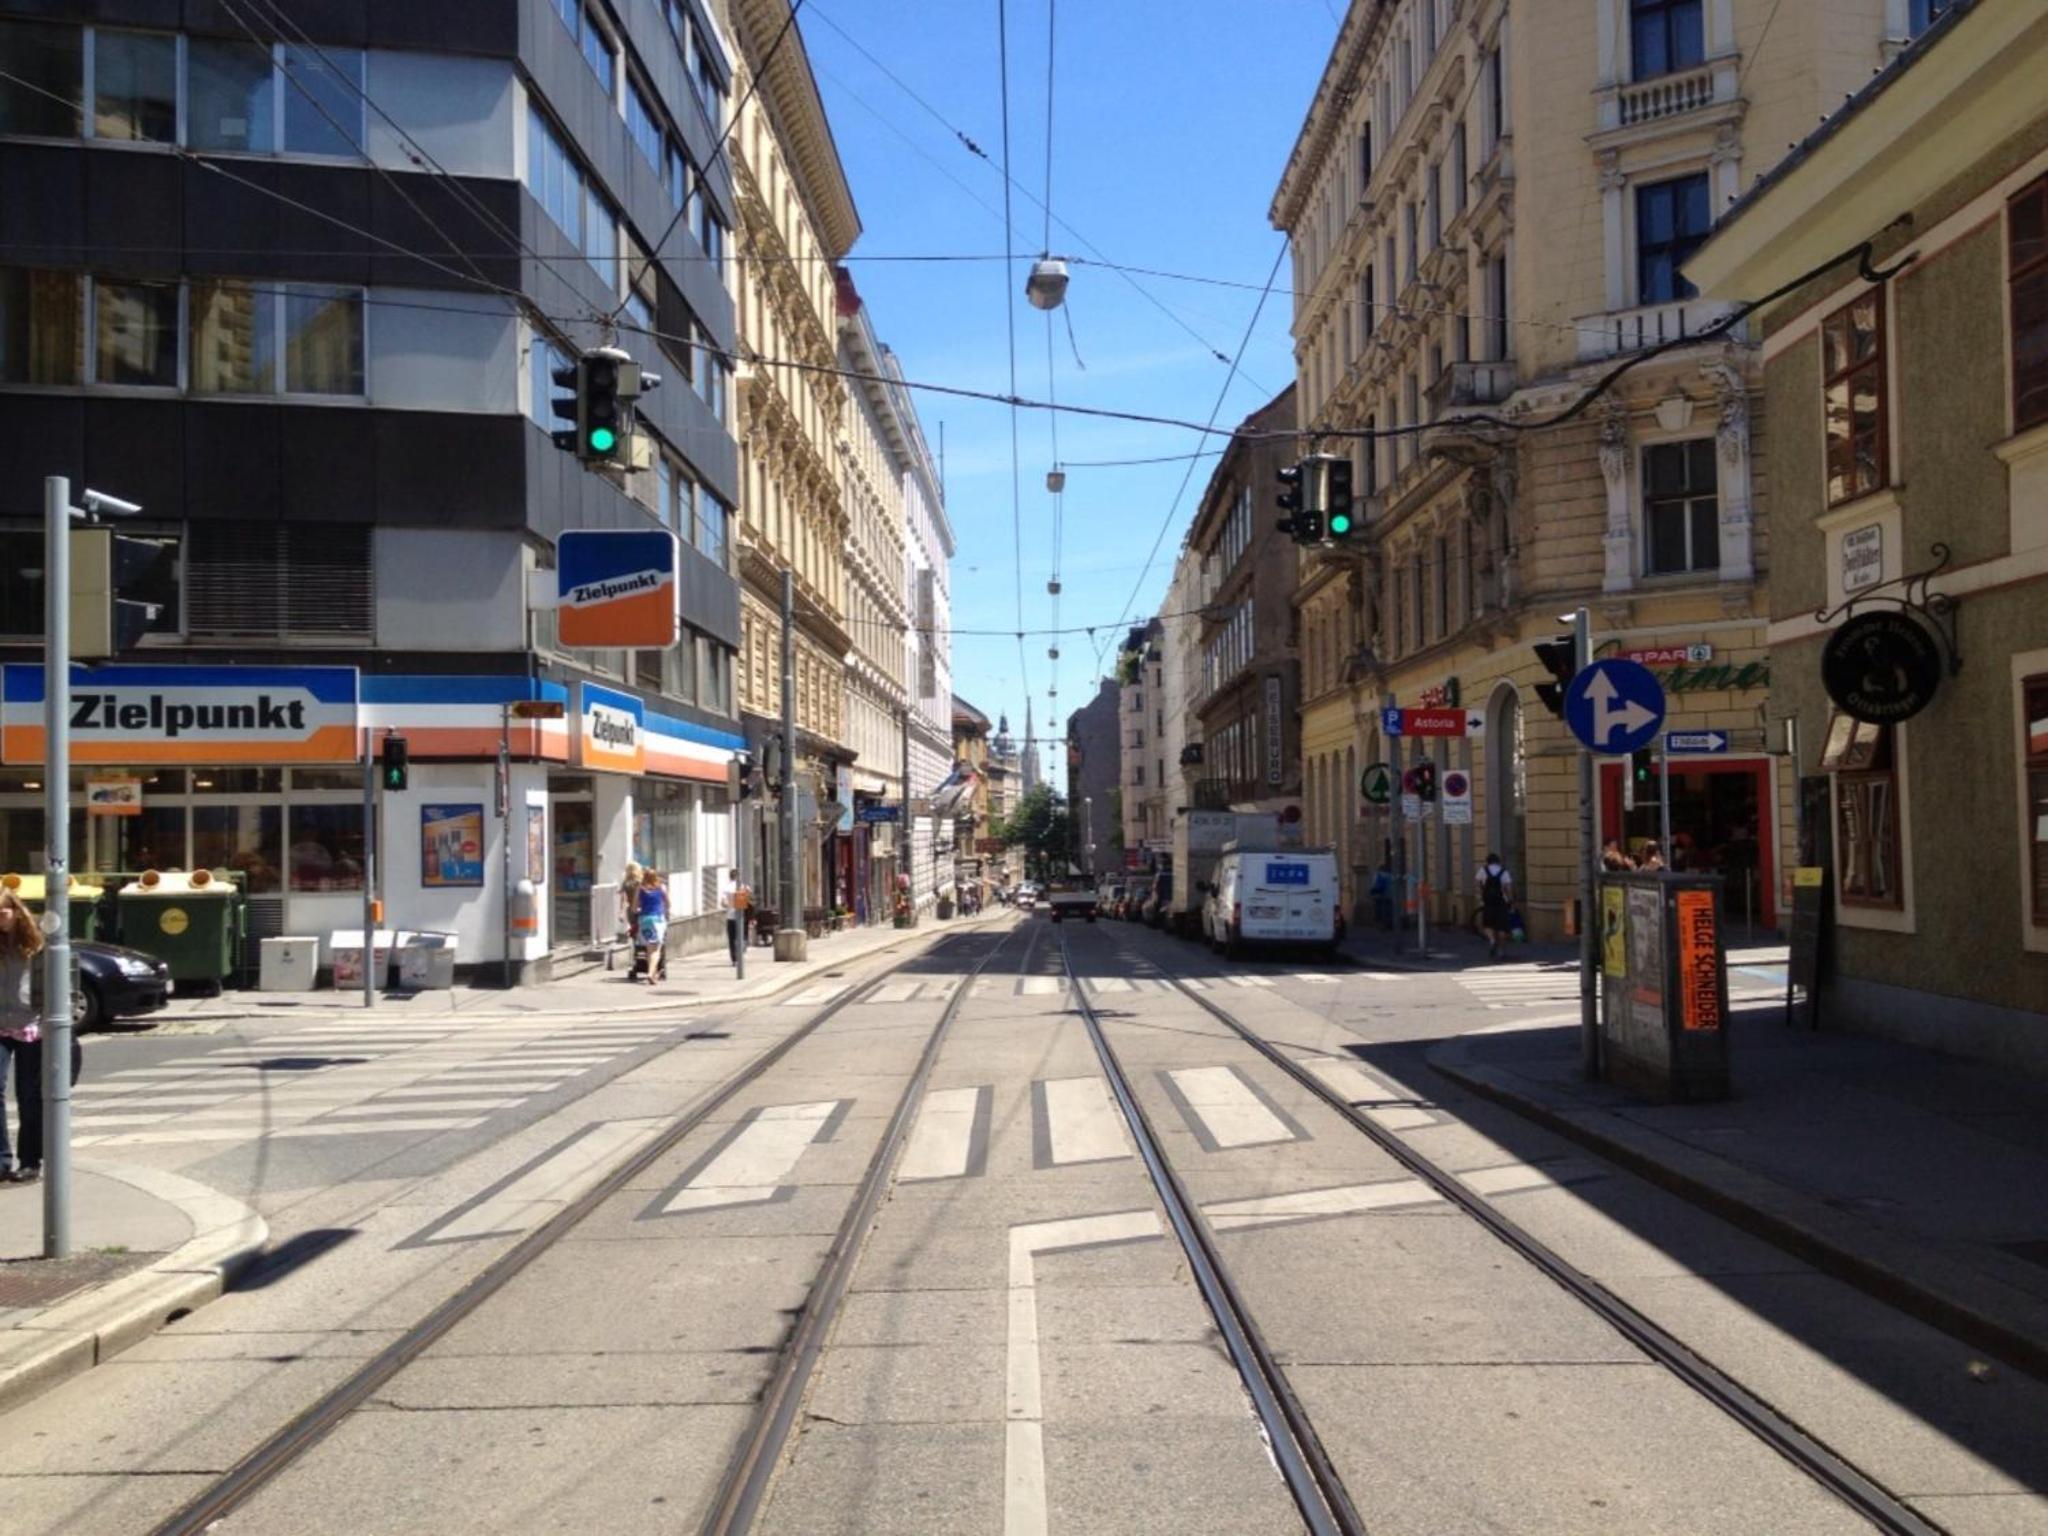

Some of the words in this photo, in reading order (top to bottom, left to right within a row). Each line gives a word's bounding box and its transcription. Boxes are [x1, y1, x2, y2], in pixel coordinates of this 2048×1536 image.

[573, 573, 658, 602] Zielpunkt
[1629, 649, 1687, 664] SPAR
[70, 695, 305, 736] Zielpunkt
[592, 710, 635, 749] Zielpunkt
[1413, 717, 1456, 729] Astoria
[1692, 907, 1715, 948] HELGE
[1694, 952, 1719, 1030] SCHNEIDER
